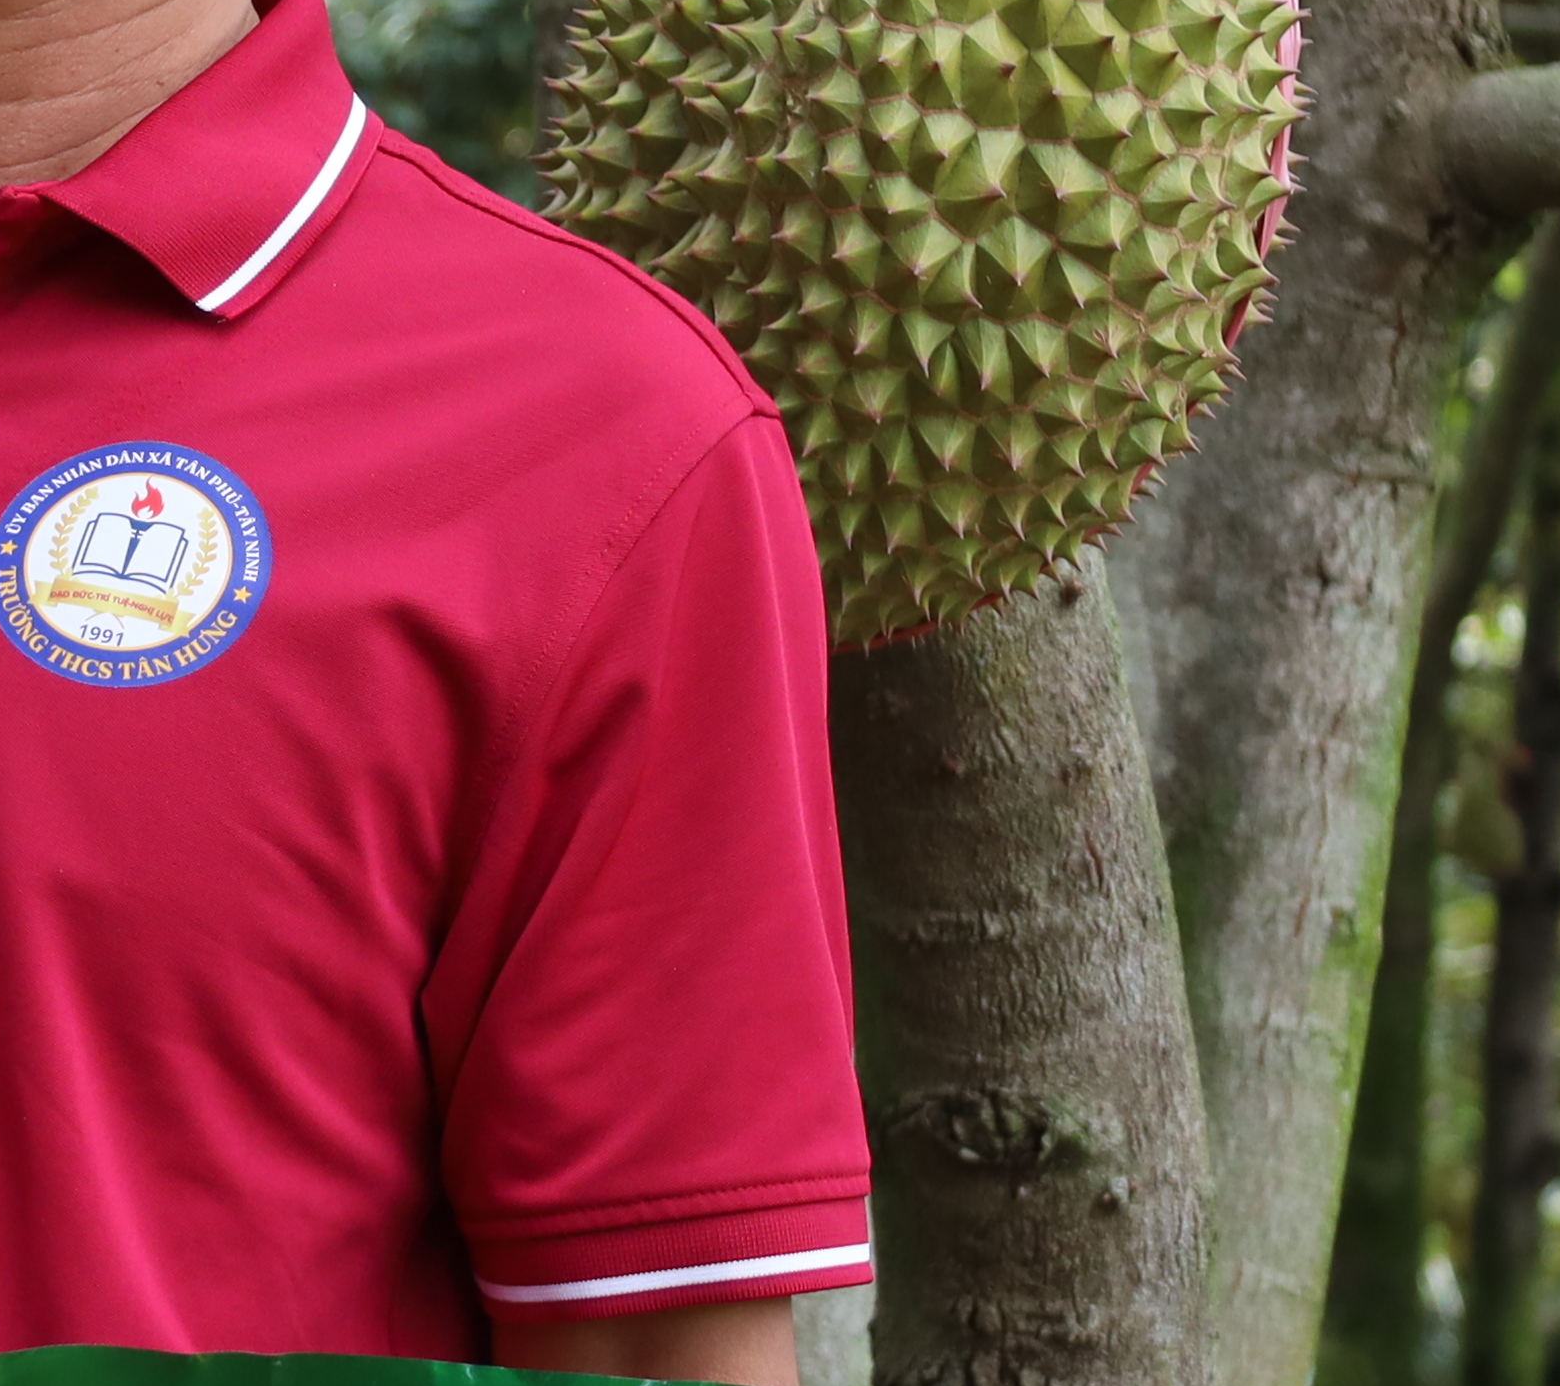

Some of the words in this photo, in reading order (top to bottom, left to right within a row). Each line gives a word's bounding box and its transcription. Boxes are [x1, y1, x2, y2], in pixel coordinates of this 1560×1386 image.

[21, 483, 54, 514] BAN
[53, 458, 103, 489] NHÂN
[105, 450, 144, 468] DÂN
[174, 455, 210, 482] TÂN
[243, 540, 260, 582] NINH
[50, 644, 114, 679] THCS
[118, 656, 173, 680] TÂN
[172, 609, 238, 668] HƯNG
[80, 624, 124, 647] 1991
